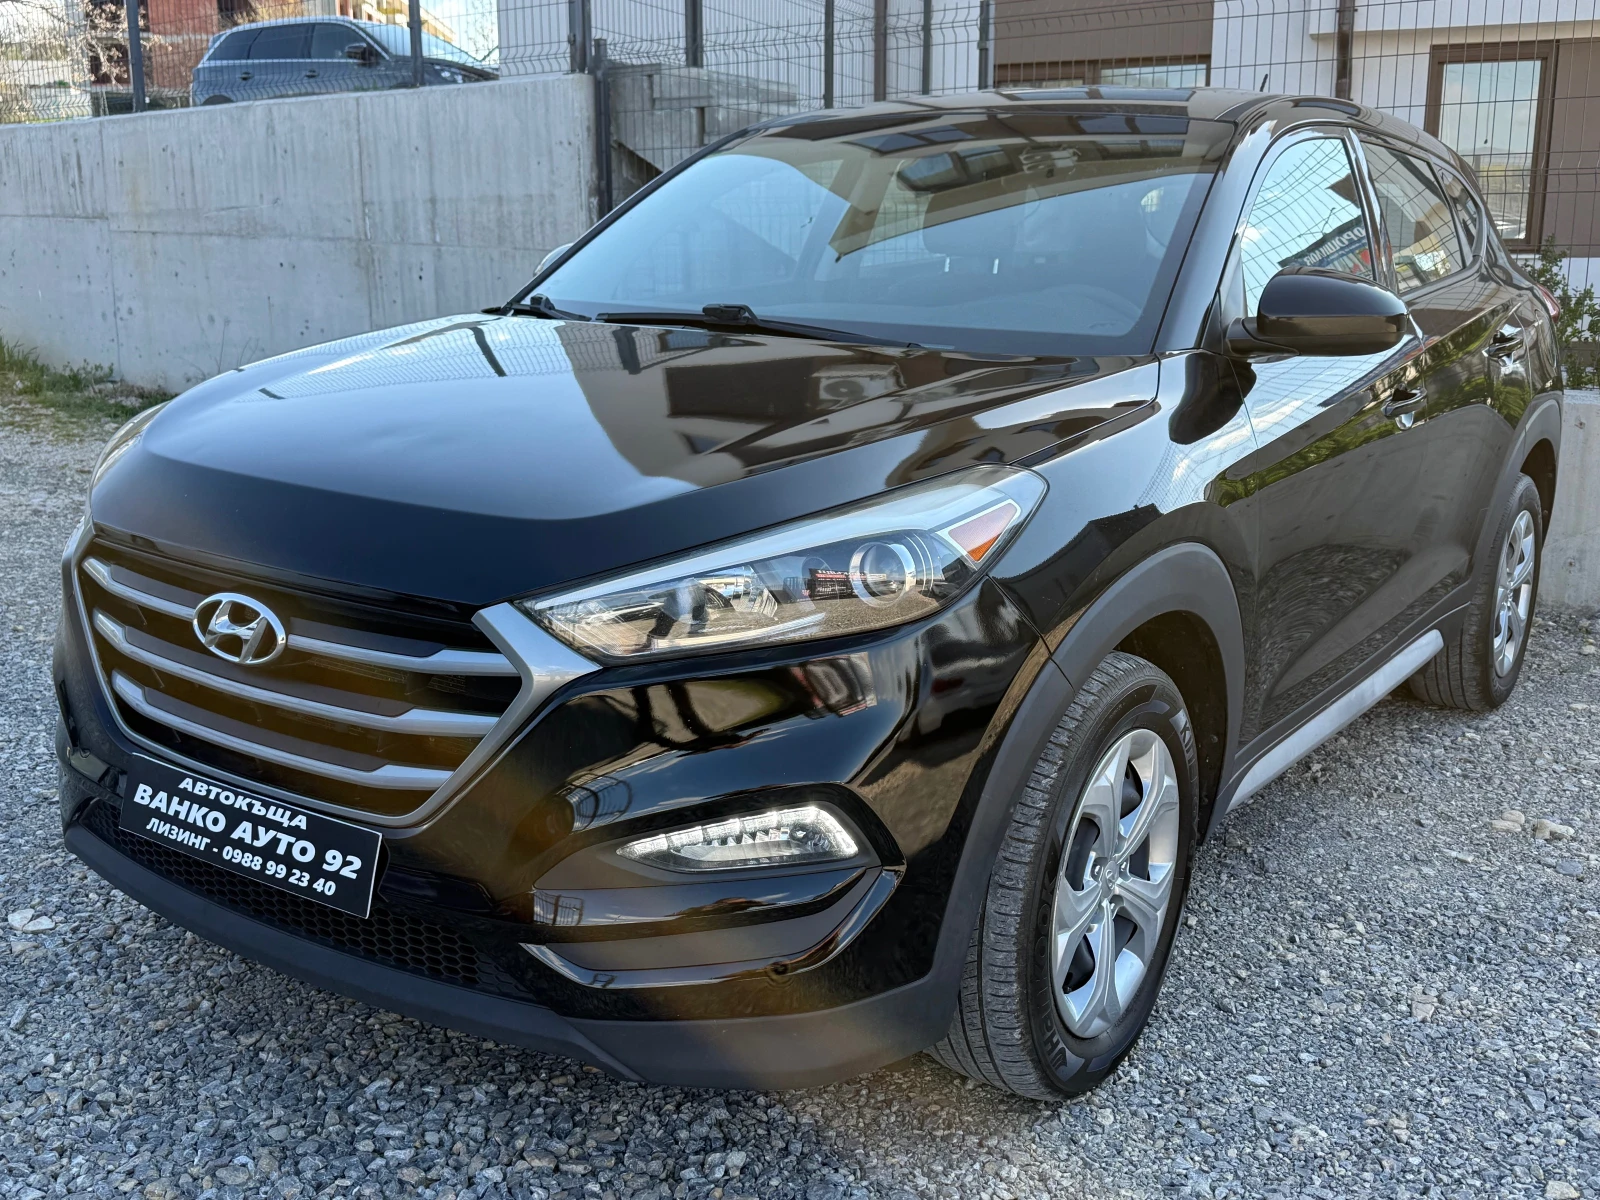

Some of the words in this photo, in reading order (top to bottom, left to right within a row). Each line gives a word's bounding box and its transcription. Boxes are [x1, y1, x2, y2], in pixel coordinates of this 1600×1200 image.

[133, 783, 226, 833] ВАНКО
[230, 820, 316, 863] АУТО
[322, 849, 362, 880] 92
[178, 777, 307, 830] АВТОКЪЩА
[146, 817, 211, 851] ЛИЗИНГ
[222, 845, 263, 871] 0988
[265, 860, 287, 879] 99
[288, 868, 310, 887] 23
[312, 877, 336, 896] 40
